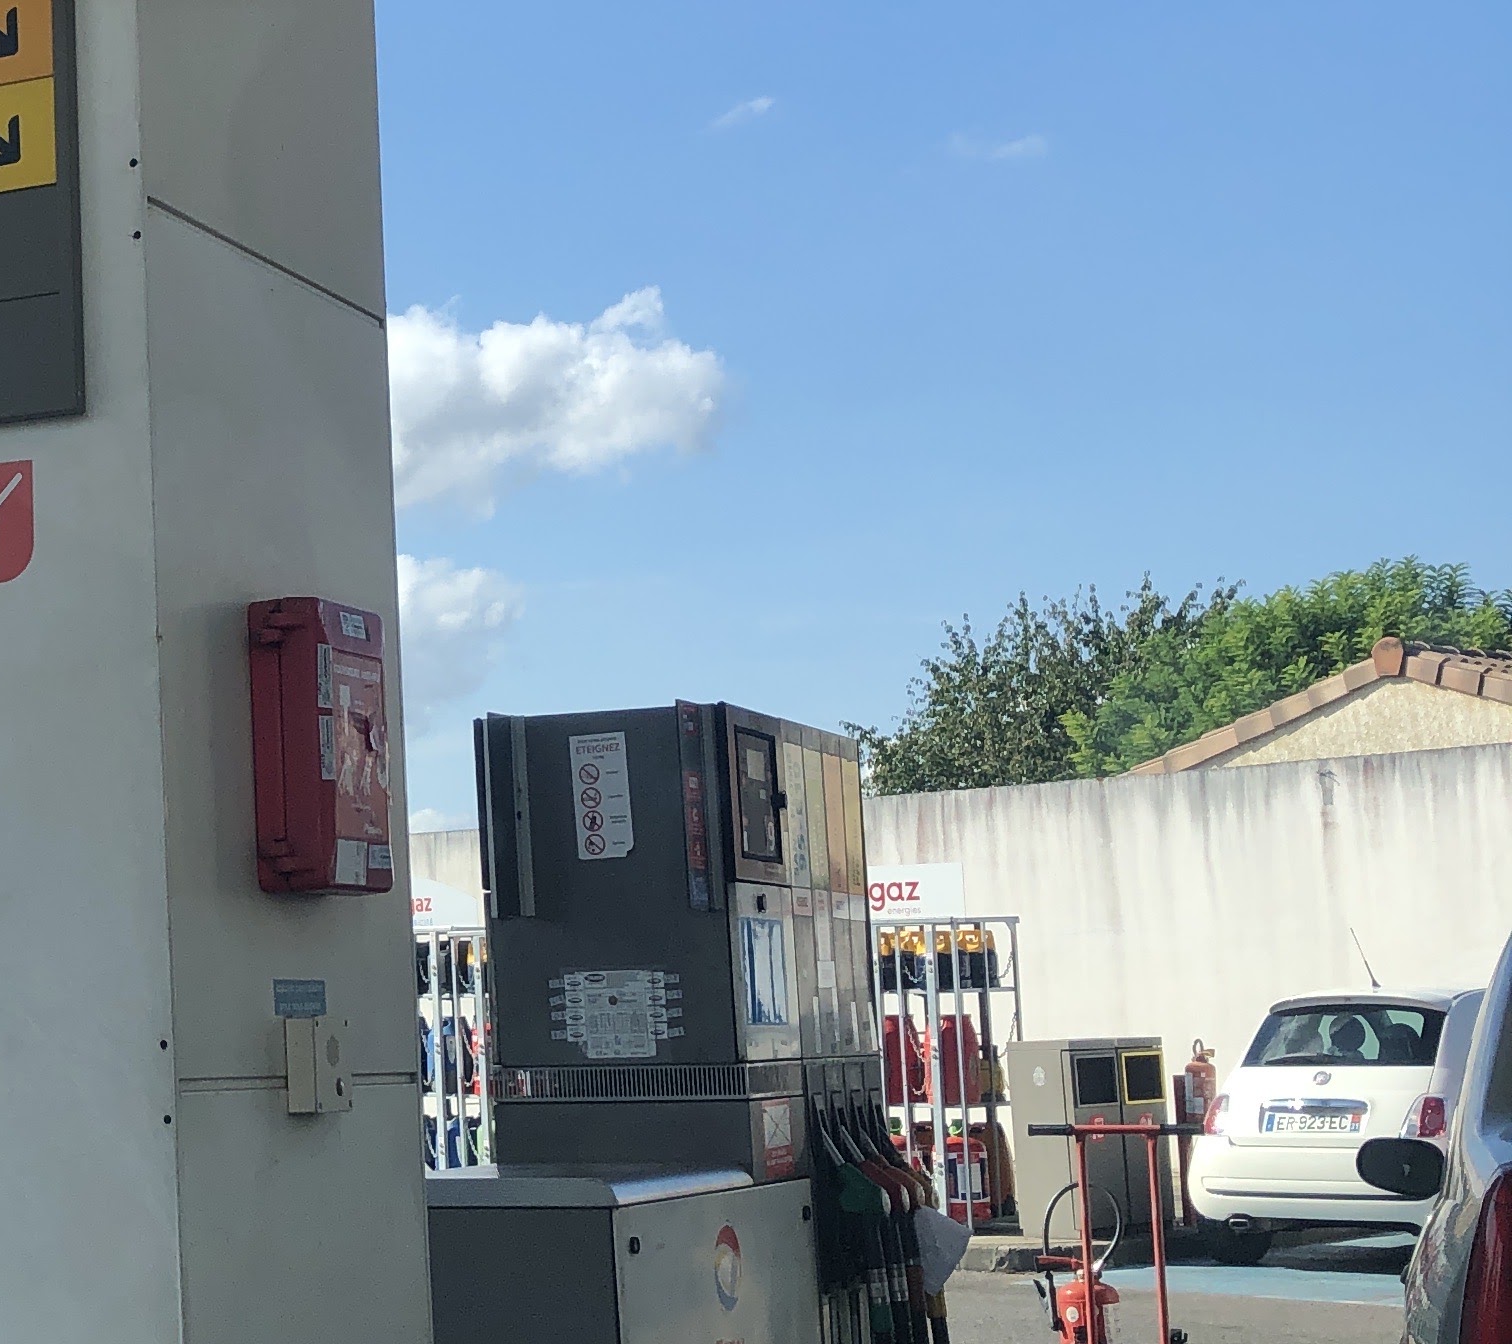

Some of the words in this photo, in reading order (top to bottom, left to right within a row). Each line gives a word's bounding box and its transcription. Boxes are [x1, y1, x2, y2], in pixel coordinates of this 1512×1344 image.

[868, 881, 921, 912] gaz
[410, 897, 433, 916] az
[1277, 1115, 1349, 1131] ER-923-EC
